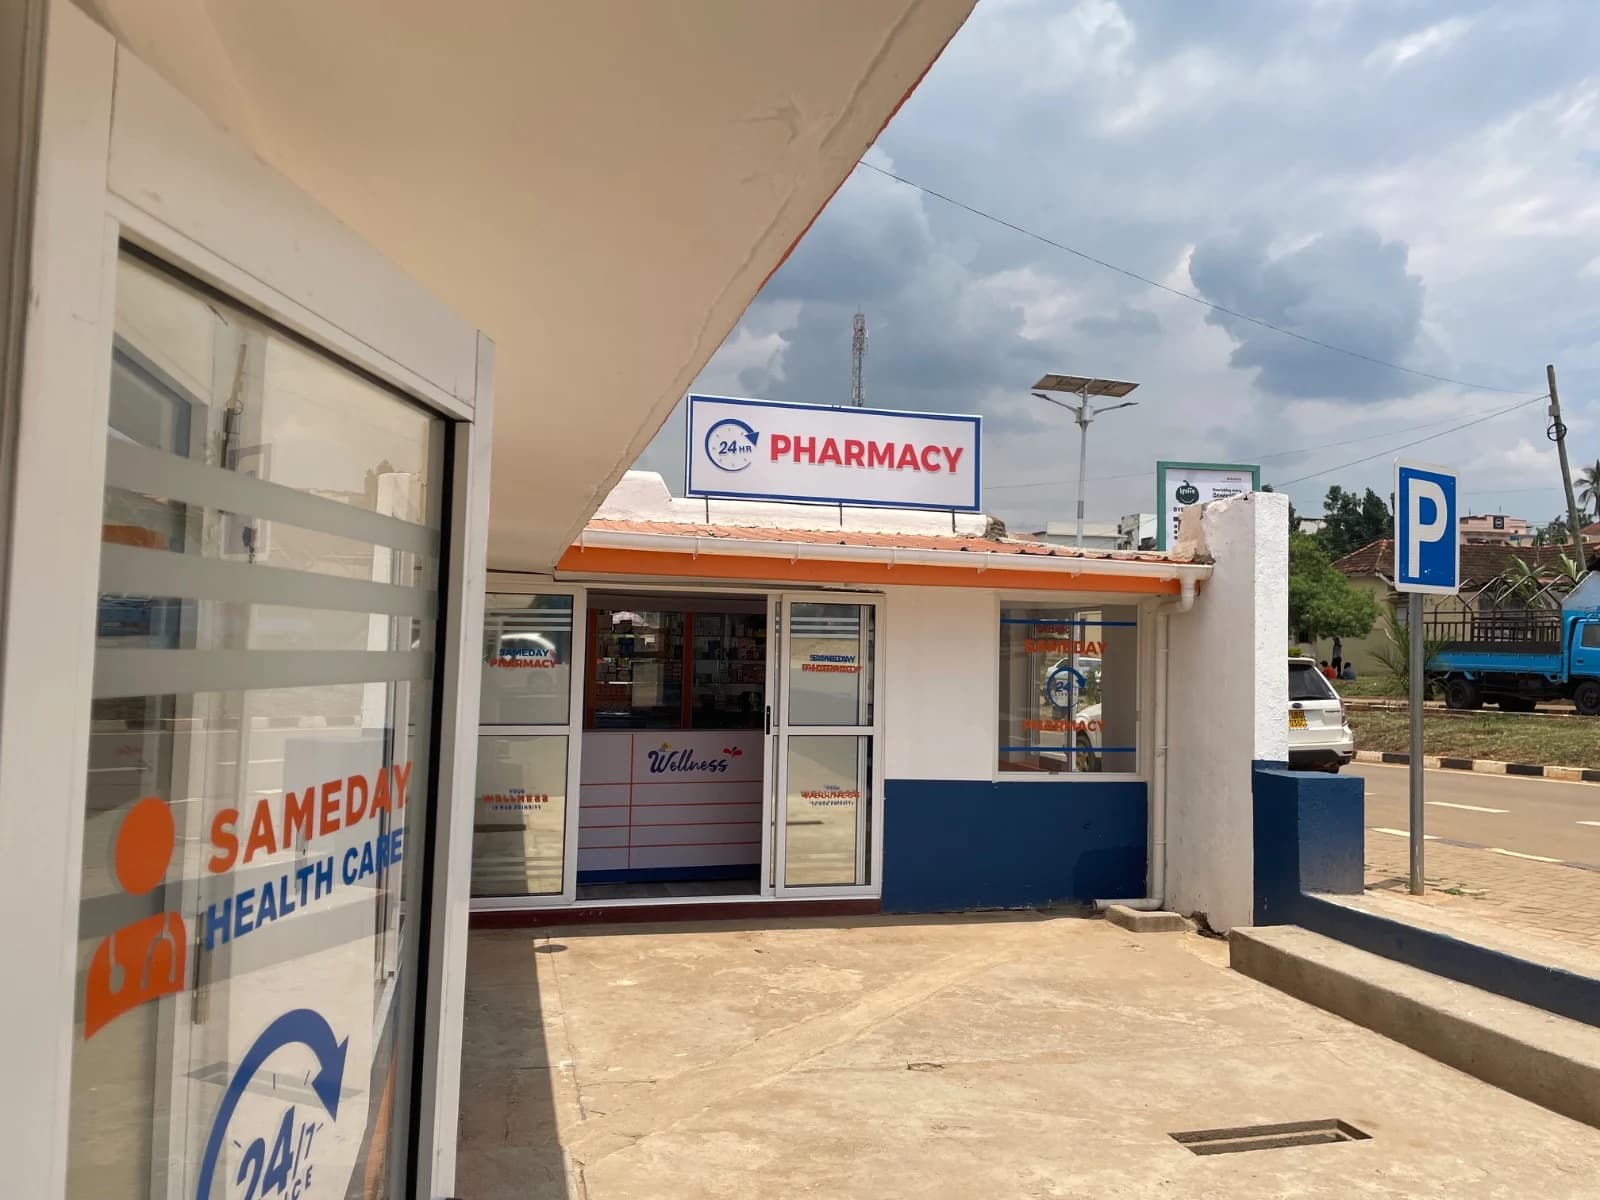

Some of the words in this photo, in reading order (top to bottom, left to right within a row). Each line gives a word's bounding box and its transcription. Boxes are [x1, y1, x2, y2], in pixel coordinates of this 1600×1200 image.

[718, 440, 738, 455] 24
[738, 445, 753, 454] HR
[770, 433, 964, 473] PHARMACY
[1407, 478, 1448, 578] P
[499, 648, 549, 657] SAMEDAY
[1023, 639, 1107, 655] SAMEDAY
[489, 658, 558, 669] PHARMACY
[1022, 719, 1107, 732] PHARMACY
[647, 749, 729, 773] Wellness
[208, 762, 412, 874] SAMEDAY
[204, 861, 334, 951] HEALTH
[342, 827, 405, 887] CARE
